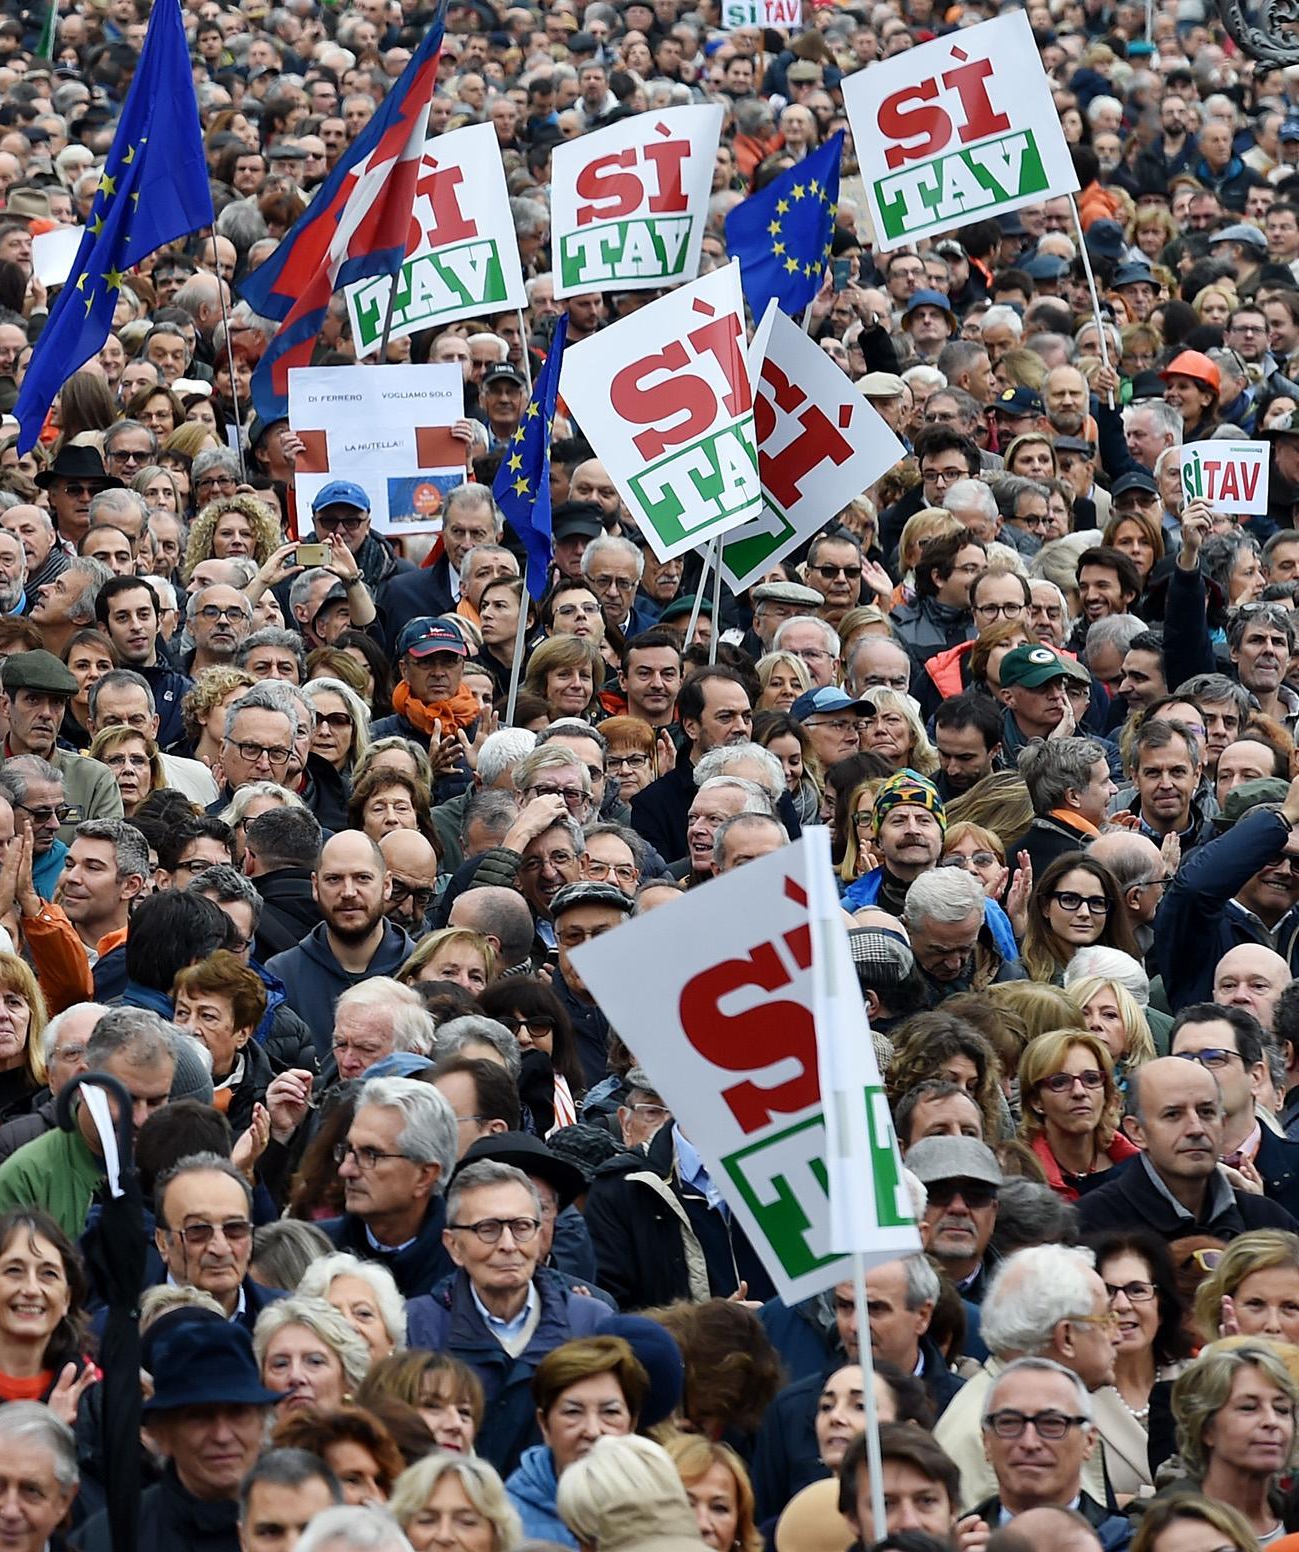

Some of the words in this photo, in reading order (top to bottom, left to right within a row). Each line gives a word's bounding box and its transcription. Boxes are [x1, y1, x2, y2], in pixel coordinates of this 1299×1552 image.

[877, 45, 1012, 170] SÌ
[576, 121, 691, 227] SÌ
[880, 133, 1029, 231] TAV
[359, 242, 494, 335] TAV
[566, 218, 691, 283] TAV
[308, 395, 317, 403] DI
[320, 393, 363, 402] FERRERO
[382, 390, 427, 399] VOGLIAMO
[429, 390, 452, 398] SOLO
[610, 297, 753, 462] SÌ
[345, 444, 356, 452] LA
[637, 421, 761, 533] TA
[679, 875, 822, 1135] S
